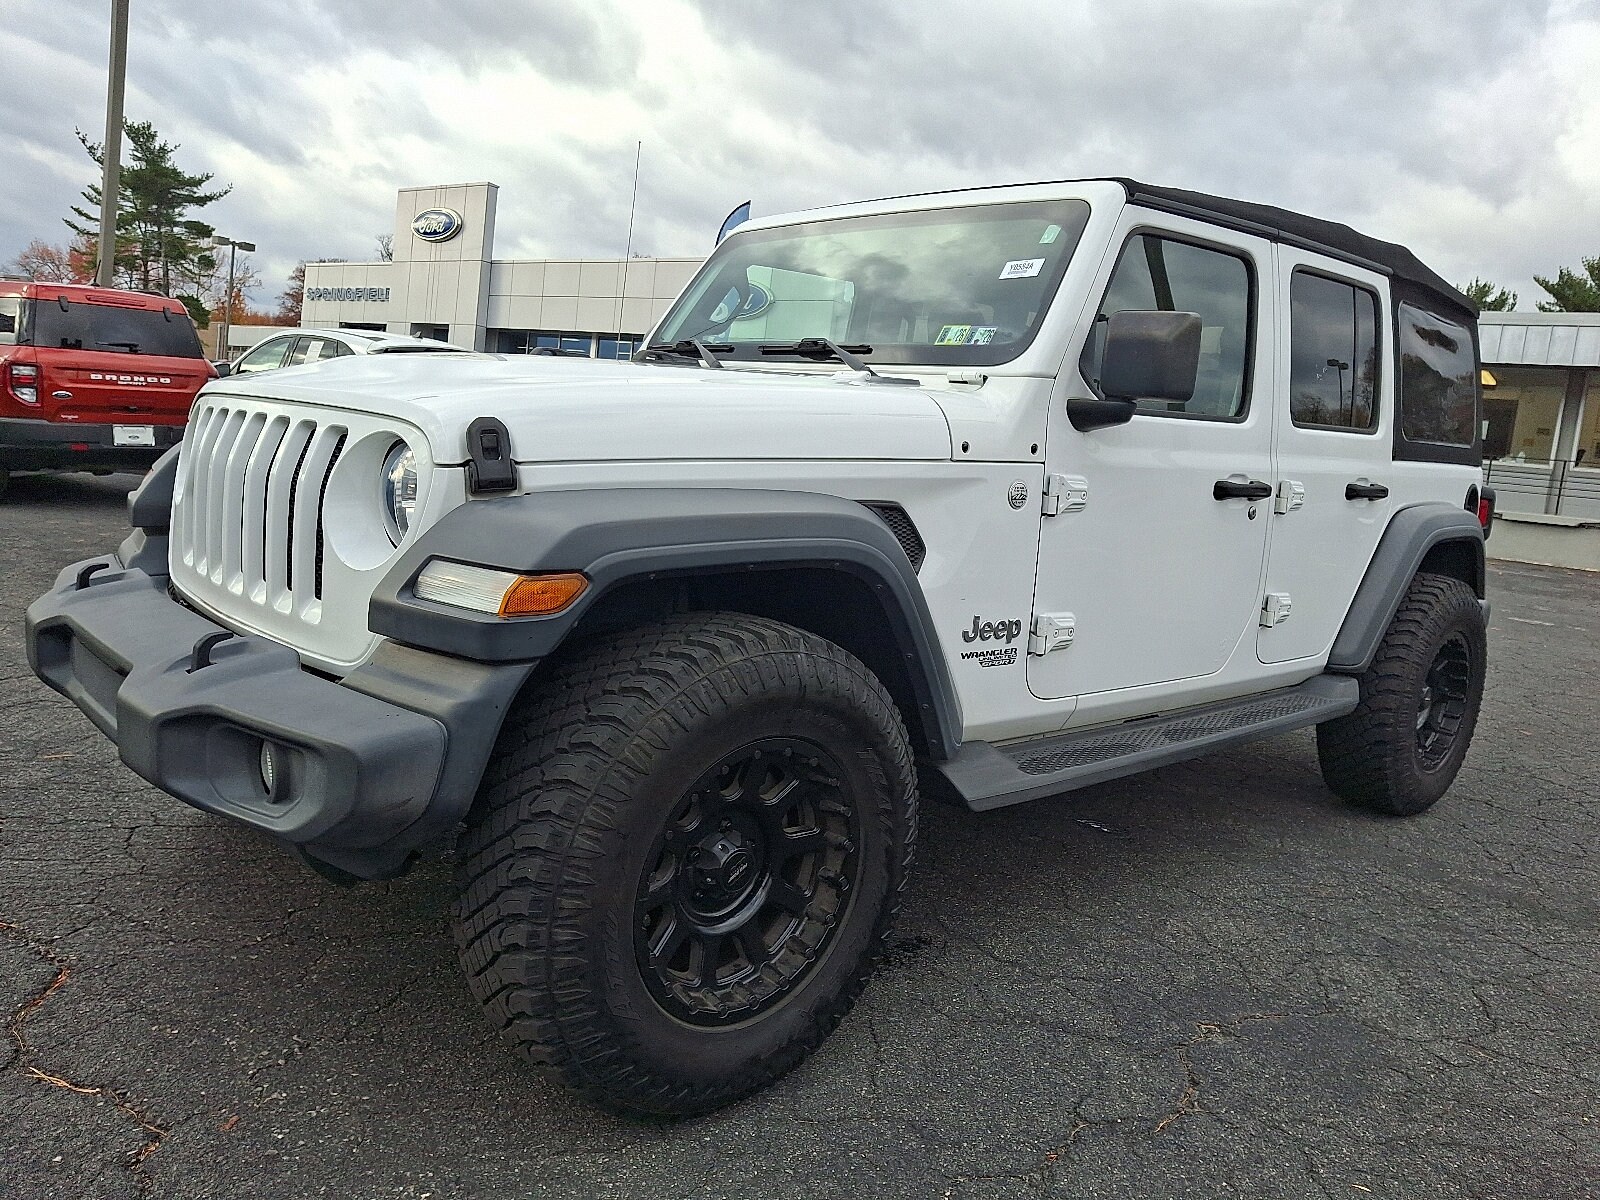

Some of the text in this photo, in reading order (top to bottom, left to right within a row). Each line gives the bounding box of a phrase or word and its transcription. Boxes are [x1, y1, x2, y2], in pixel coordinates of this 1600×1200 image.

[412, 214, 449, 233] Ford
[90, 373, 171, 384] BRONCO
[962, 614, 1022, 645] Jeep
[961, 648, 1017, 659] WRANGLER
